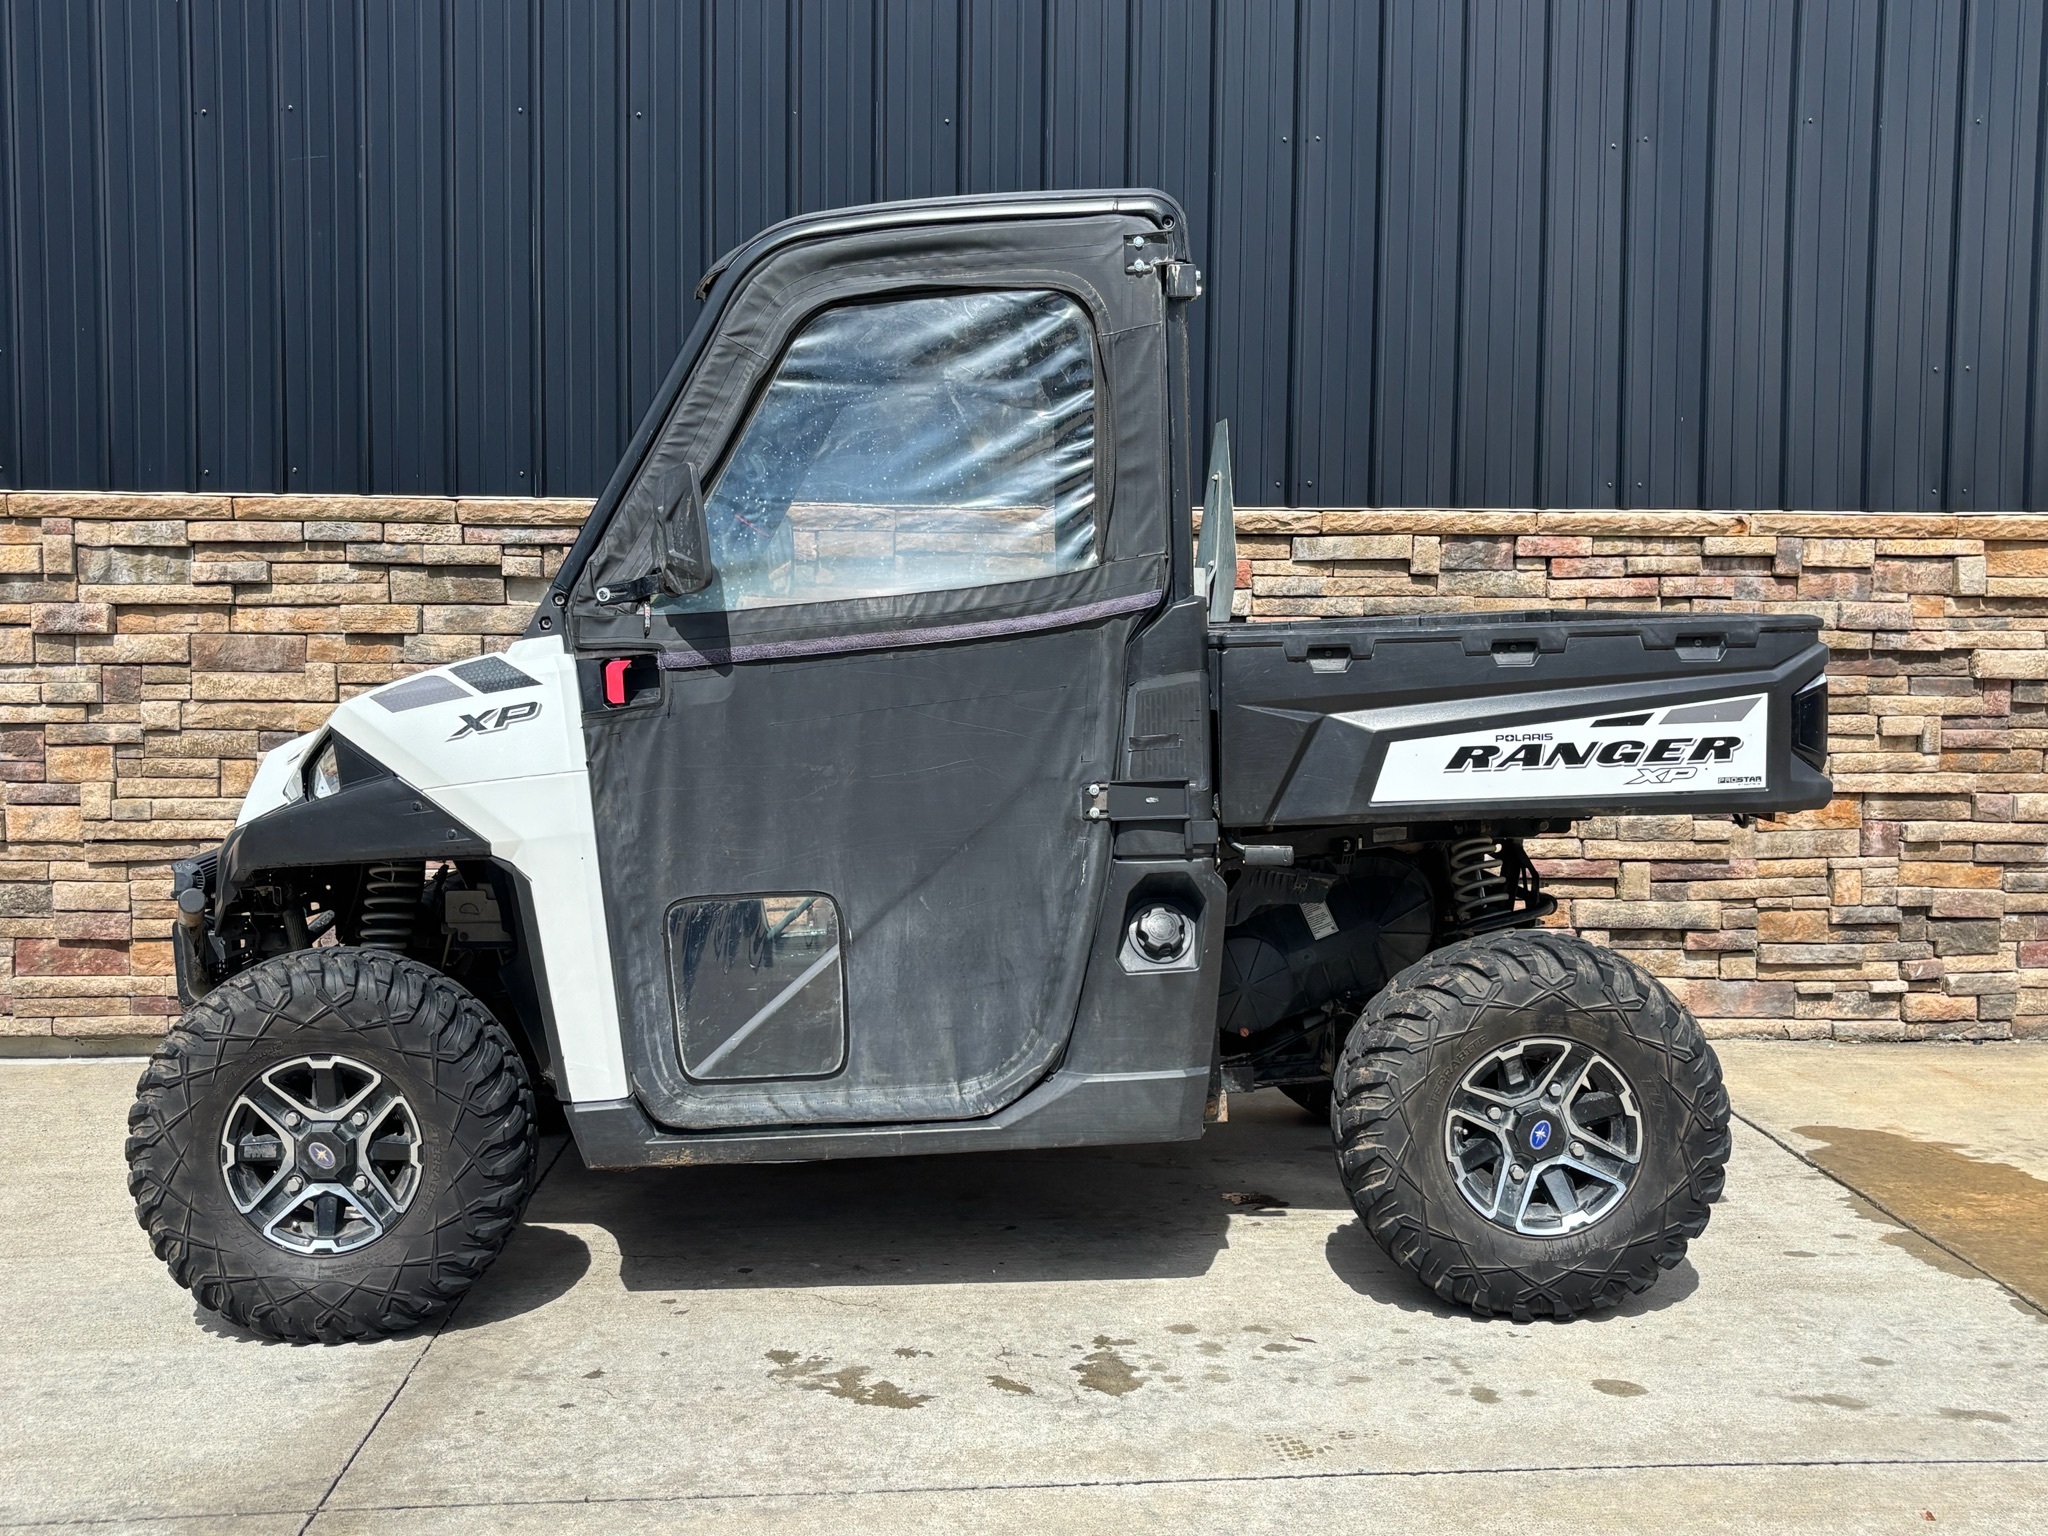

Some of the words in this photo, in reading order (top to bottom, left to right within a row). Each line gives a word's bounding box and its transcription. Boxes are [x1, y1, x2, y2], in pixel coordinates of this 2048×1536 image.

[445, 701, 542, 742] XP
[1495, 733, 1554, 743] POLARIS
[1443, 736, 1745, 773] RANGER
[1623, 766, 1698, 786] XP
[1718, 776, 1762, 784] PROSTAR
[1429, 1034, 1488, 1101] TERRABITE
